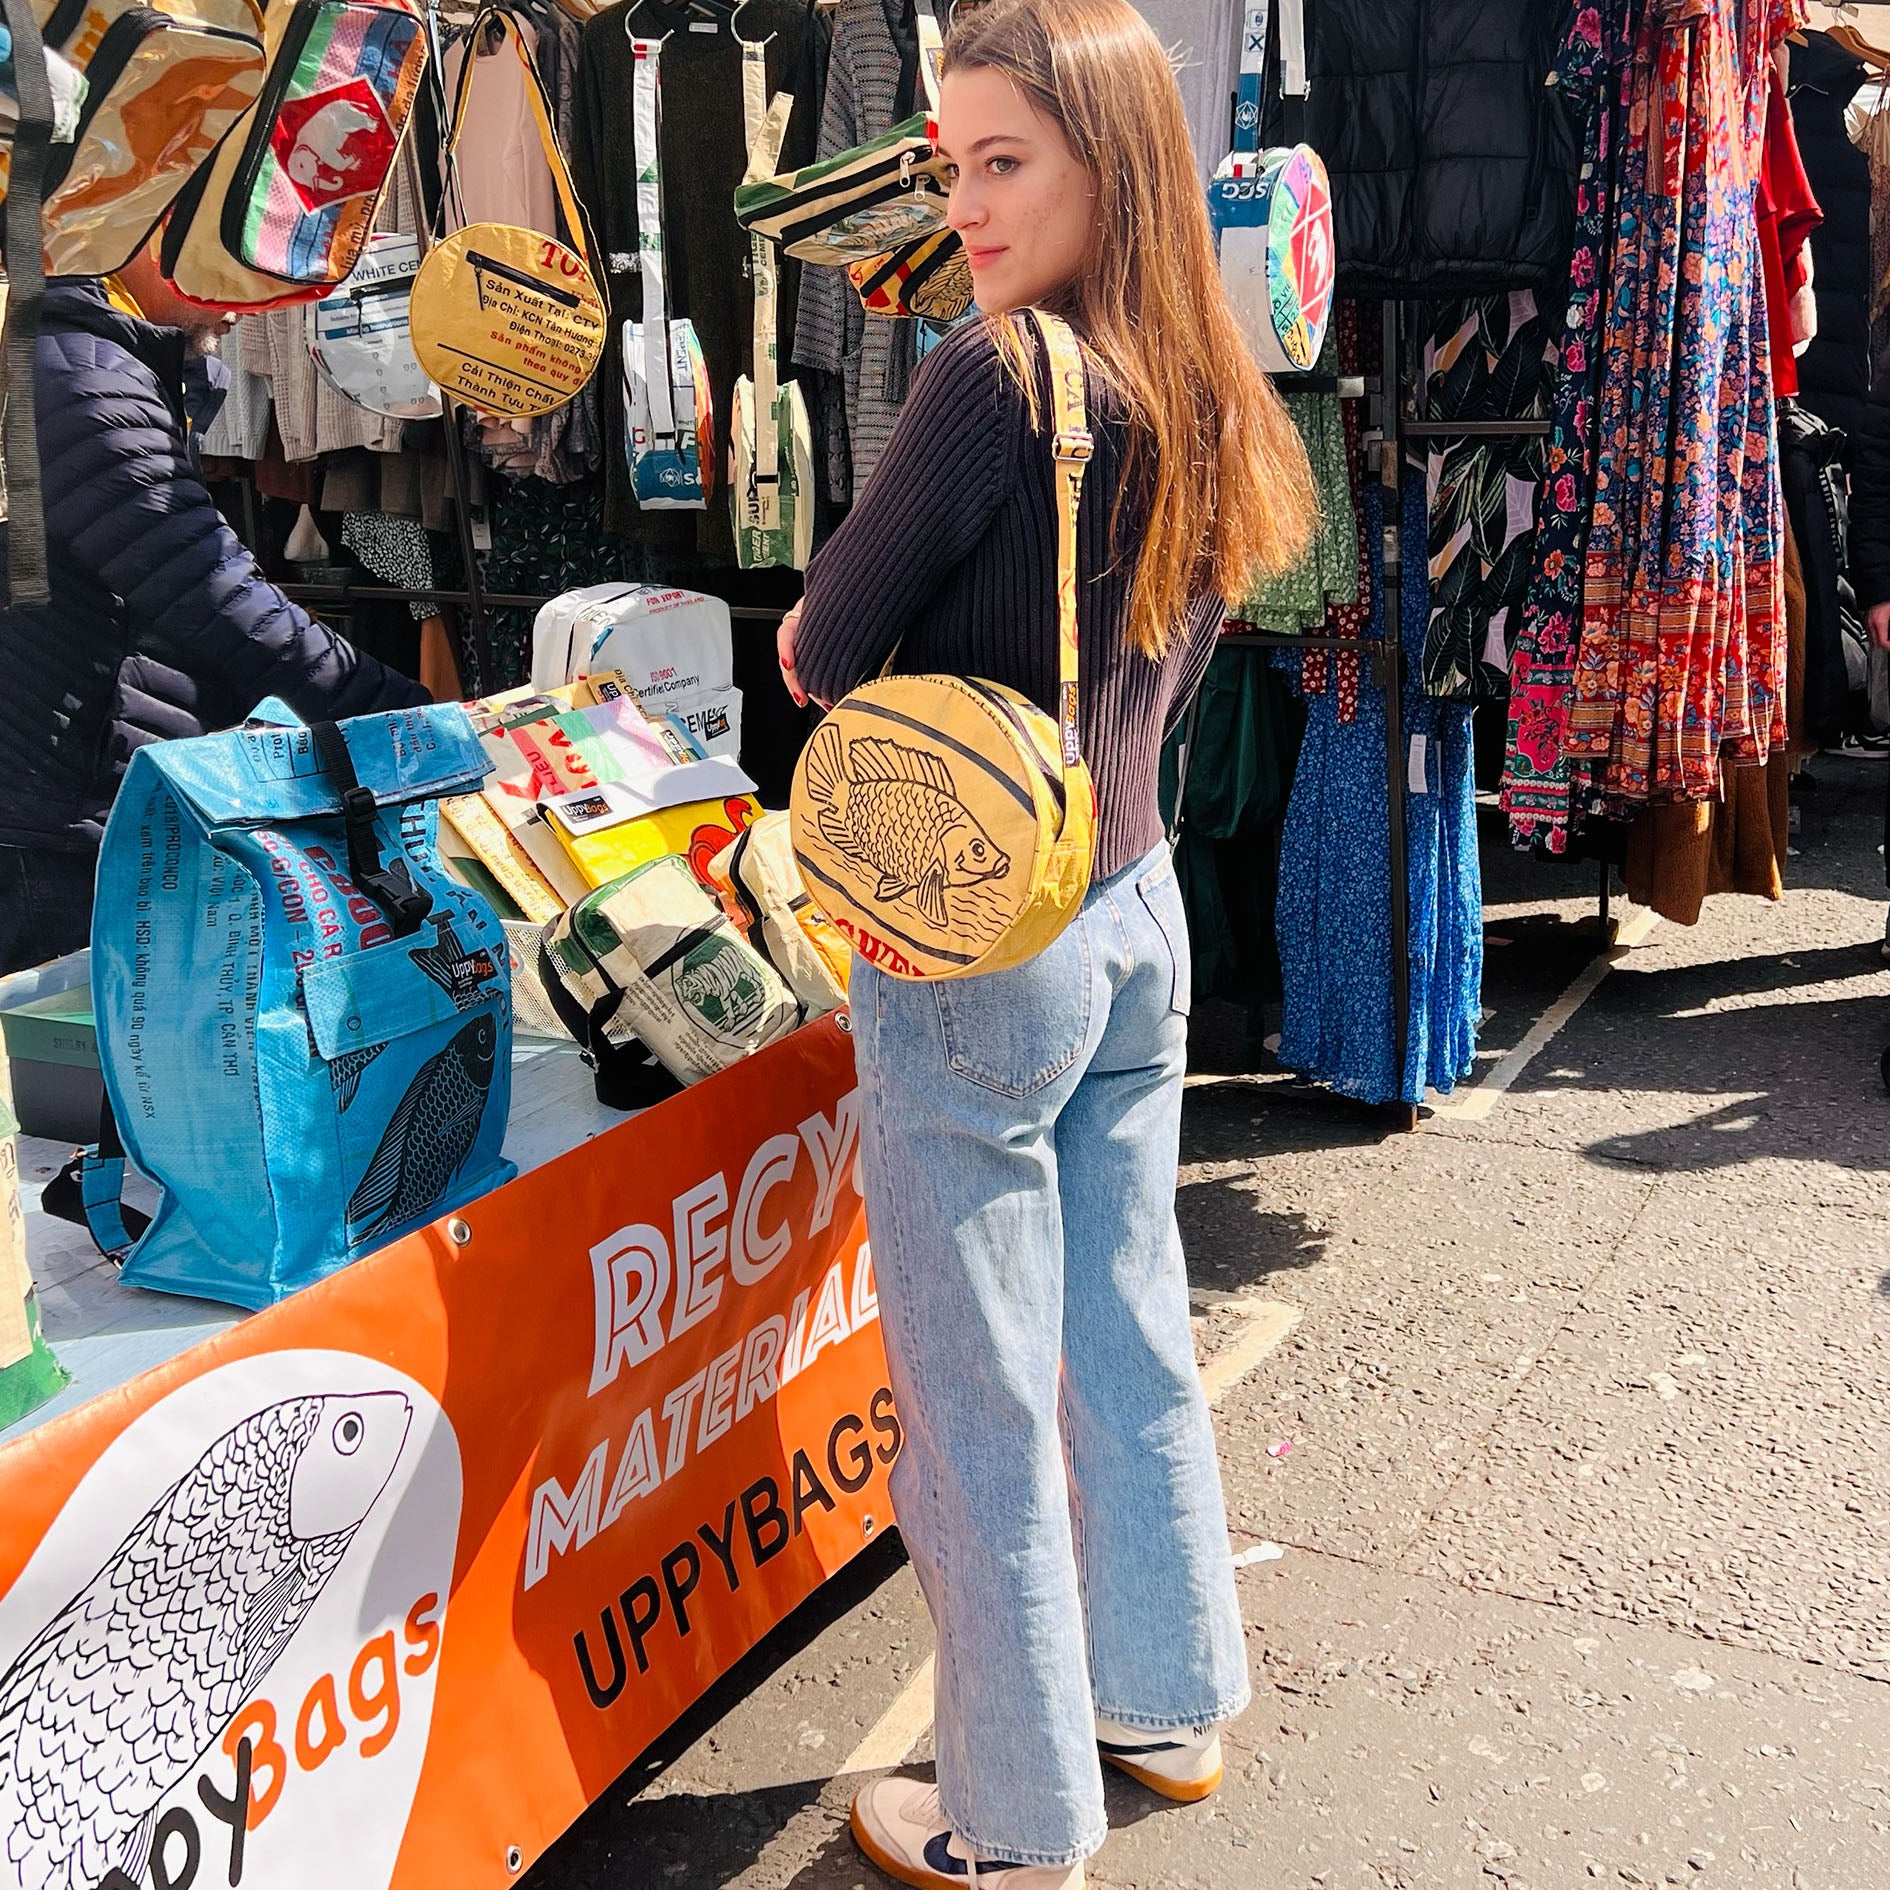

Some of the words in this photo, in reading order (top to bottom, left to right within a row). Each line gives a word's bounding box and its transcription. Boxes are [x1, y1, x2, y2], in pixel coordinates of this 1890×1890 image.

[352, 263, 396, 281] WHITE
[485, 279, 511, 296] Sản
[514, 289, 544, 310] Xuất
[573, 314, 600, 331] CTY
[509, 320, 531, 337] Điện
[521, 310, 543, 325] KCN
[522, 357, 547, 373] theo
[549, 369, 569, 383] quy
[550, 353, 582, 375] không
[457, 375, 497, 399] Thành
[487, 371, 522, 392] Thiện
[525, 387, 555, 406] Chất
[664, 674, 701, 692] Company
[562, 803, 609, 816] UppyBags
[270, 856, 309, 924] G/CON
[298, 861, 329, 905] CHO
[317, 908, 346, 940] CÁ
[206, 902, 220, 928] Nam
[131, 953, 152, 988] không
[451, 959, 494, 979] UppyBags
[130, 992, 148, 1012] quá
[130, 1016, 146, 1031] 90
[127, 1034, 146, 1062] ngày
[137, 1096, 157, 1120] NSX
[573, 1387, 902, 1709] UPPYBAGS
